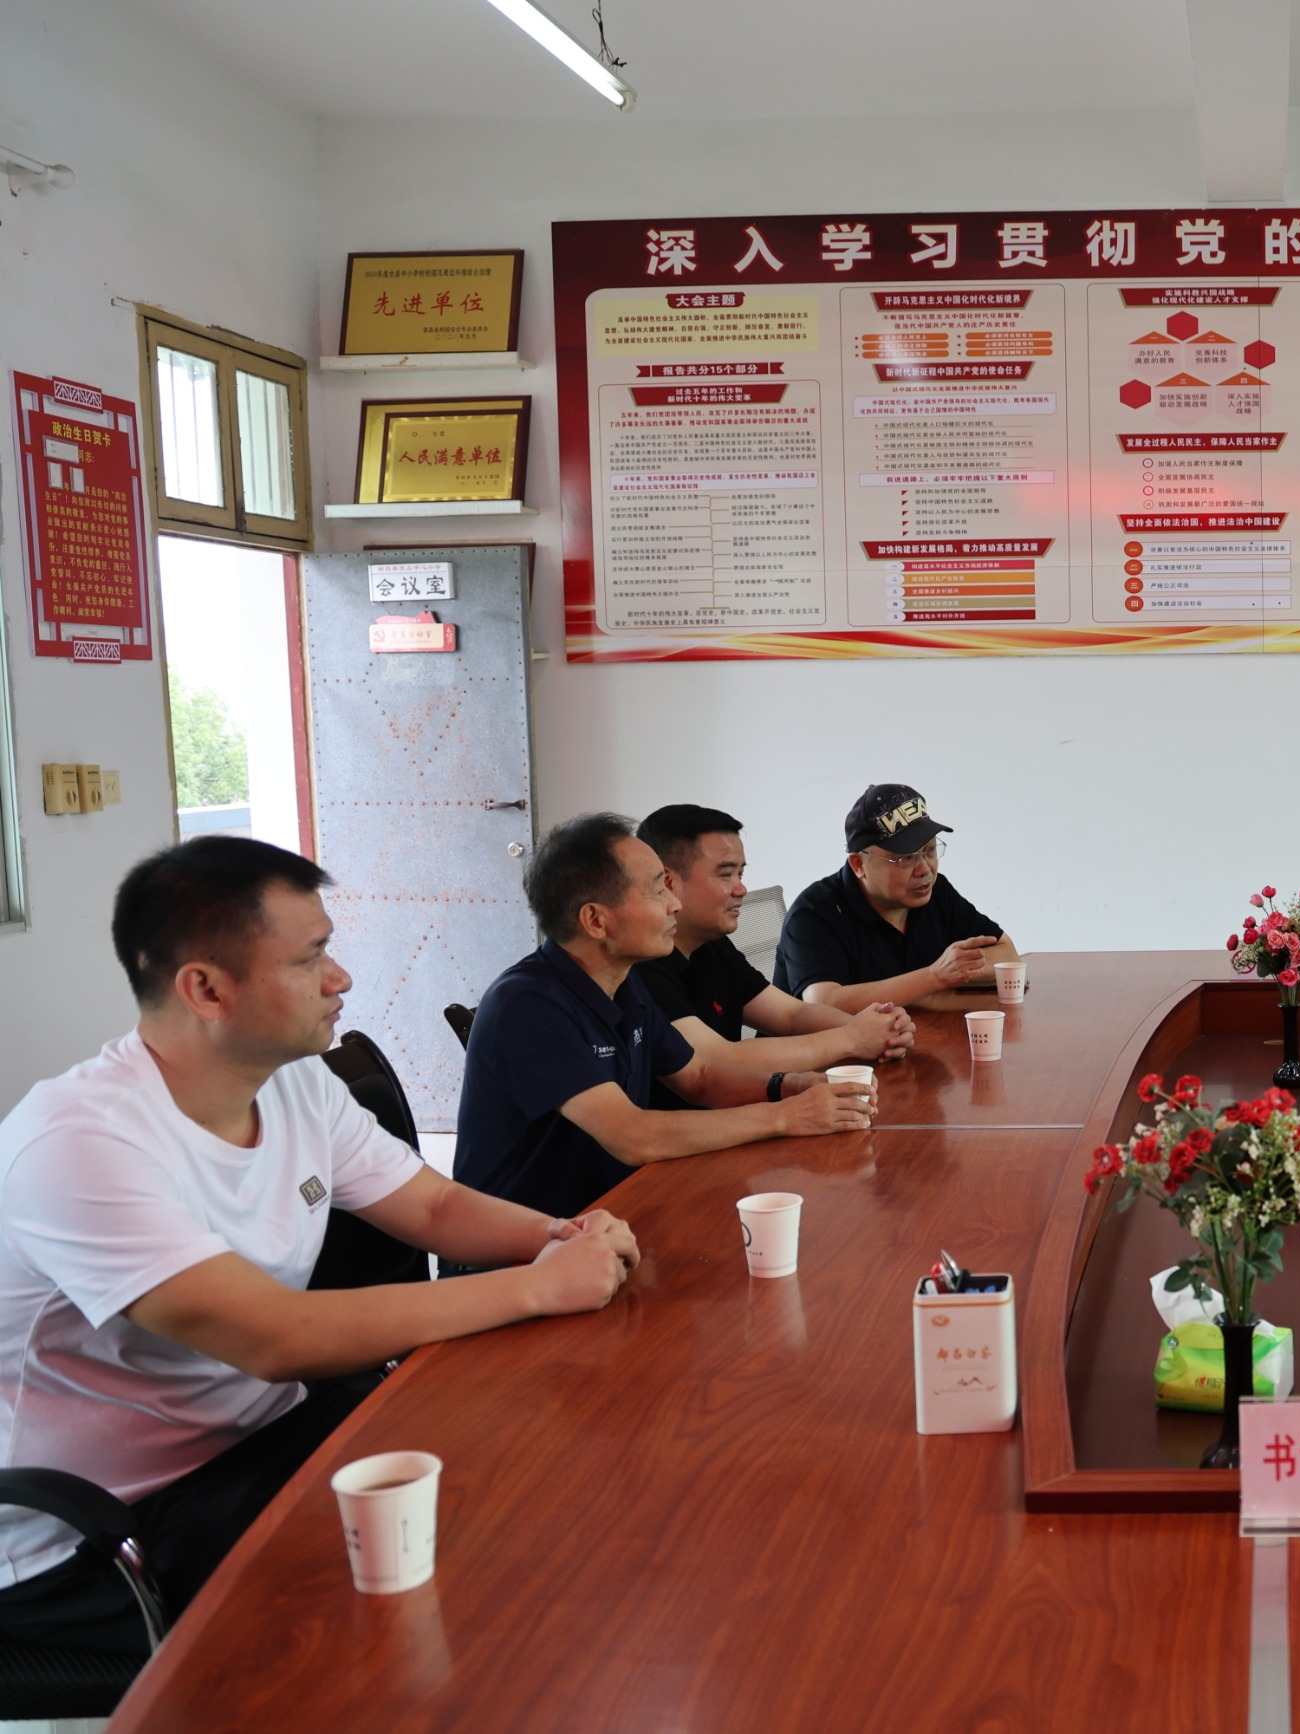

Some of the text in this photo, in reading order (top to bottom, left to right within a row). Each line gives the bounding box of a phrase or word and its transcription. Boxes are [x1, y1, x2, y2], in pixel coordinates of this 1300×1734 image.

[373, 291, 484, 316] 先进单位
[676, 294, 736, 307] 大会主题
[884, 294, 1020, 305] 开辟马克思主义中国化时代化新境界
[1152, 296, 1248, 304] 强化现代化建设人才支撑
[663, 365, 757, 375] 报告共分15个部分
[886, 366, 1022, 377] 新时代新征程中国共产党的使命任务
[676, 387, 742, 395] 过去五年的工作和
[668, 394, 751, 403] 新时代十年的伟大变革
[52, 421, 111, 448] 政治生日贺卡
[1127, 437, 1277, 447] 发展全过程人民民主，保障人民当家作主
[399, 446, 502, 466] 人民满意单位
[1158, 459, 1243, 467] 加强人民当家作主制度保障
[64, 482, 70, 491] 年
[1127, 517, 1280, 527] 坚持全面依法治国，推进法治中国建设
[878, 543, 1038, 554] 加快构建新发展格局，着力推动高质量发展
[376, 575, 446, 596] 会议室
